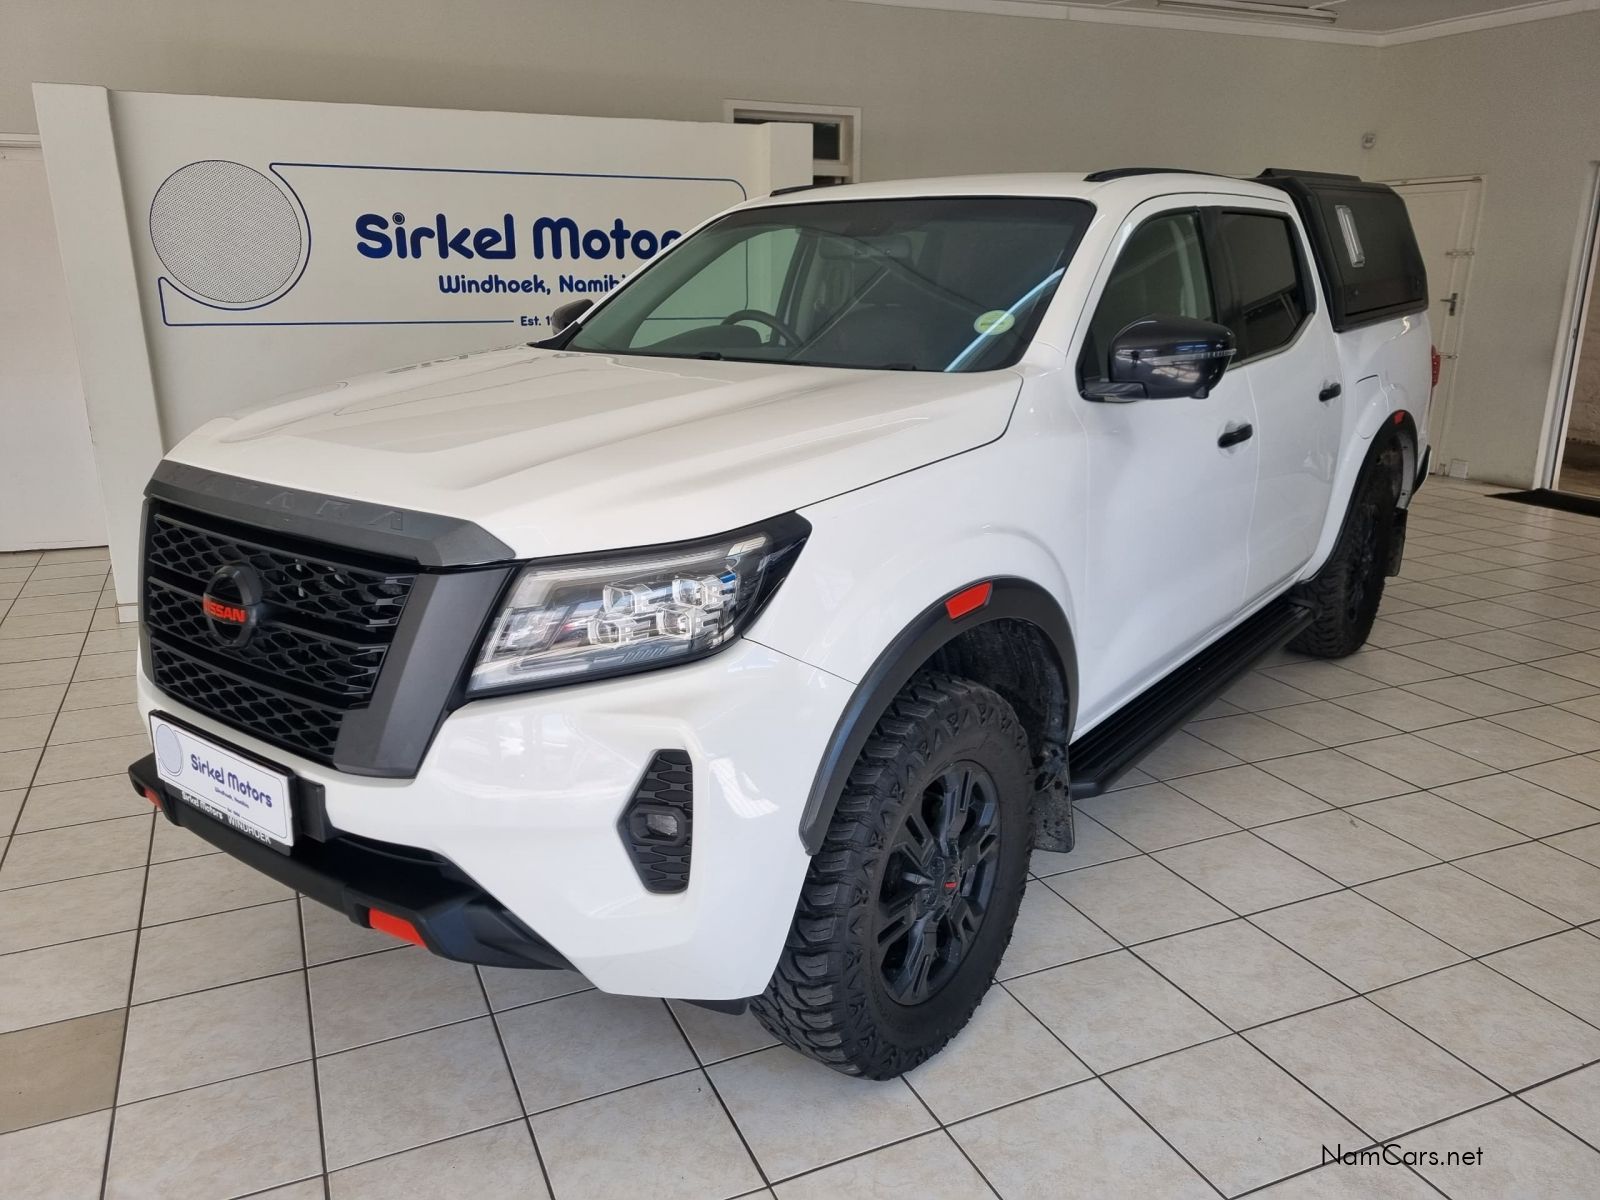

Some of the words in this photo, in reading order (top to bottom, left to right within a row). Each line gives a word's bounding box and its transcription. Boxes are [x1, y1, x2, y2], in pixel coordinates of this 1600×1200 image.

[355, 212, 516, 259] Sirkel
[532, 216, 682, 260] Motor
[438, 275, 551, 295] Windhoek,
[520, 315, 542, 326] Est.
[191, 753, 225, 784] Sirkel
[227, 771, 273, 808] Motors
